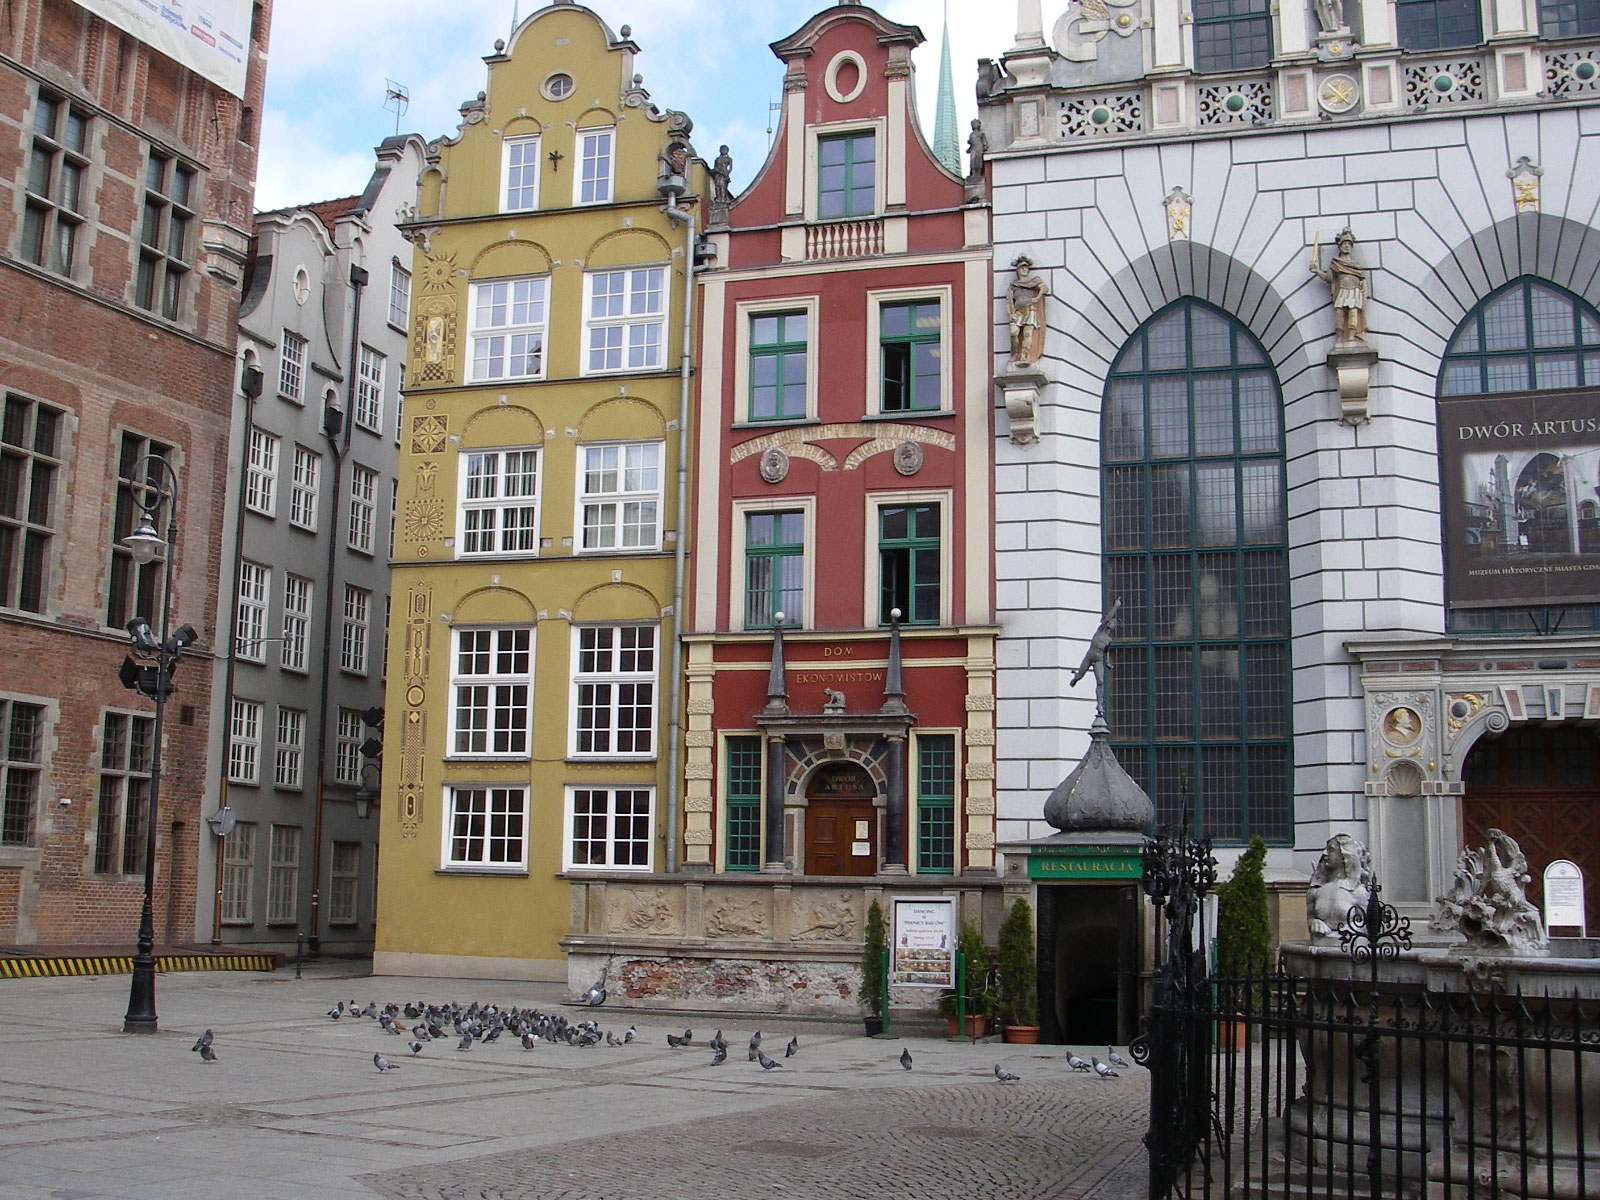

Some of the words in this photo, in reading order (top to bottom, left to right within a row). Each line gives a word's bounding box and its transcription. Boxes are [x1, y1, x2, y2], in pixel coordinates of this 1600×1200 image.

[1459, 421, 1525, 440] DWÓR
[1502, 566, 1553, 575] HISTORYCZNE
[1555, 564, 1581, 572] MIASTA
[824, 647, 853, 657] DOM
[824, 783, 864, 791] ARTUSA
[1041, 862, 1133, 872] RESTAURACJA
